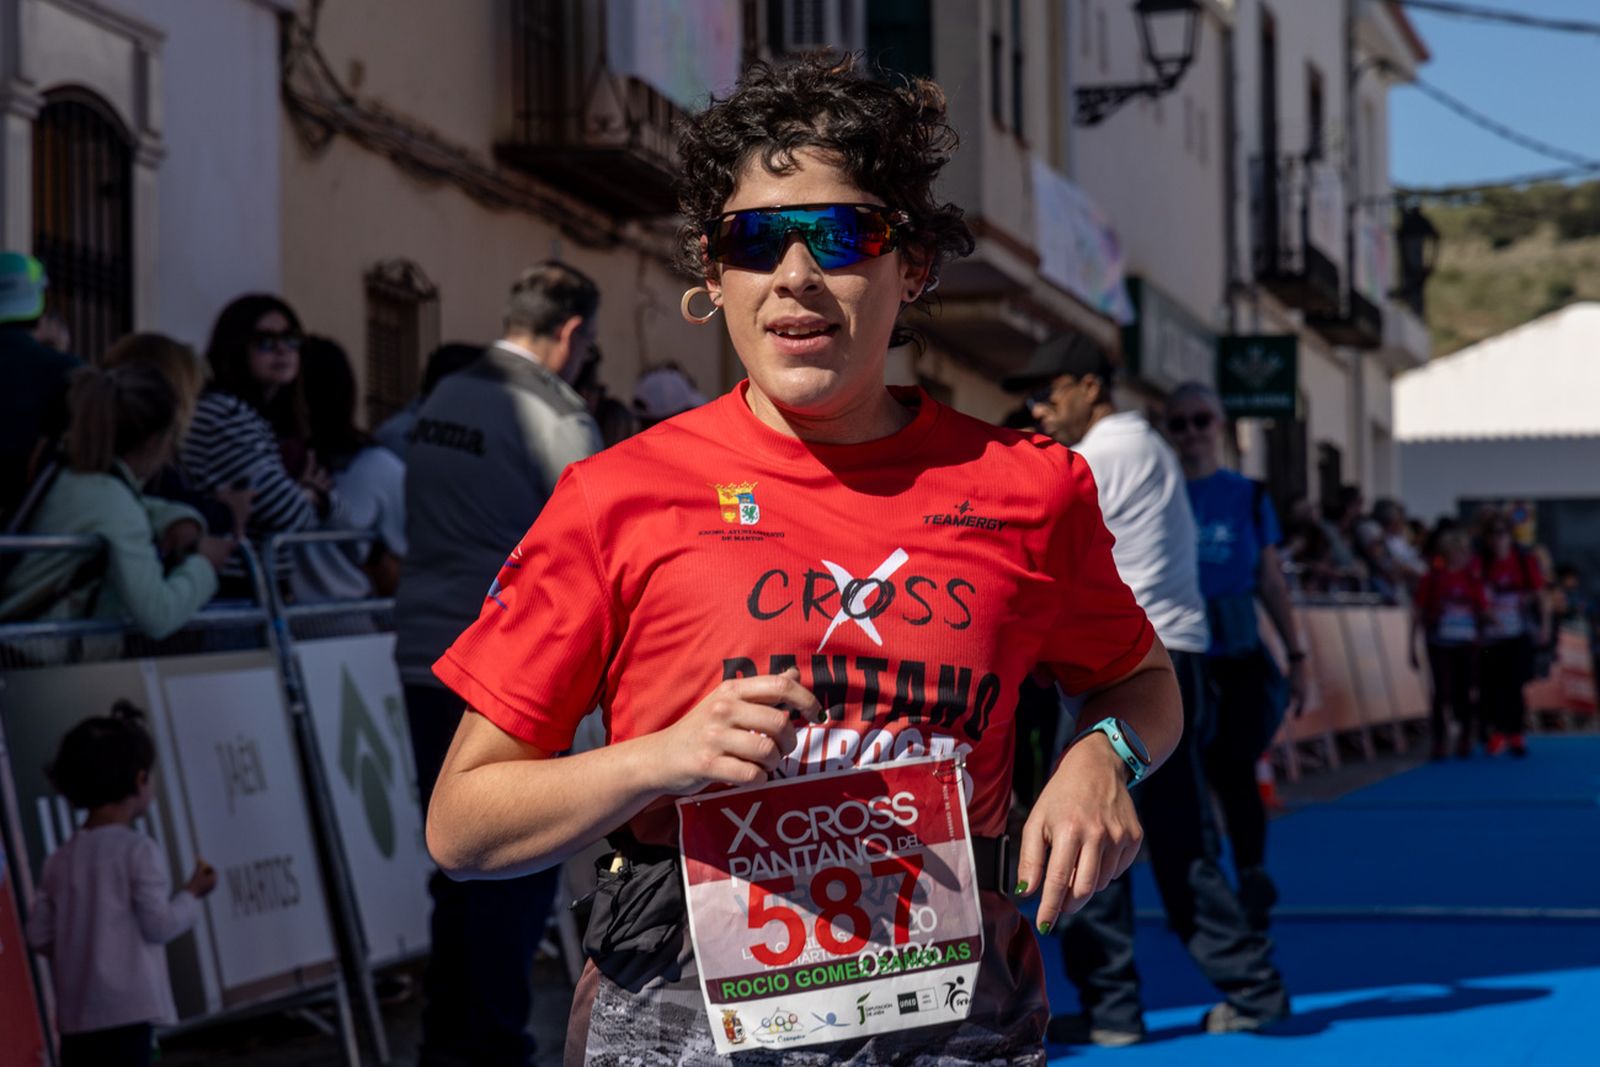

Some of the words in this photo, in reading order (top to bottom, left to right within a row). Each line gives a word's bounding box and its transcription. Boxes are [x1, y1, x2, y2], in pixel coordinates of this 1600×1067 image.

[923, 513, 1008, 532] TEAMERGY
[746, 568, 976, 630] CROSS
[720, 801, 770, 854] X
[776, 791, 919, 845] CROSS
[728, 832, 892, 888] PANTANO
[896, 833, 924, 850] DEL
[748, 854, 924, 967] 587
[721, 974, 790, 999] ROCIO
[795, 961, 871, 988] GOMEZ
